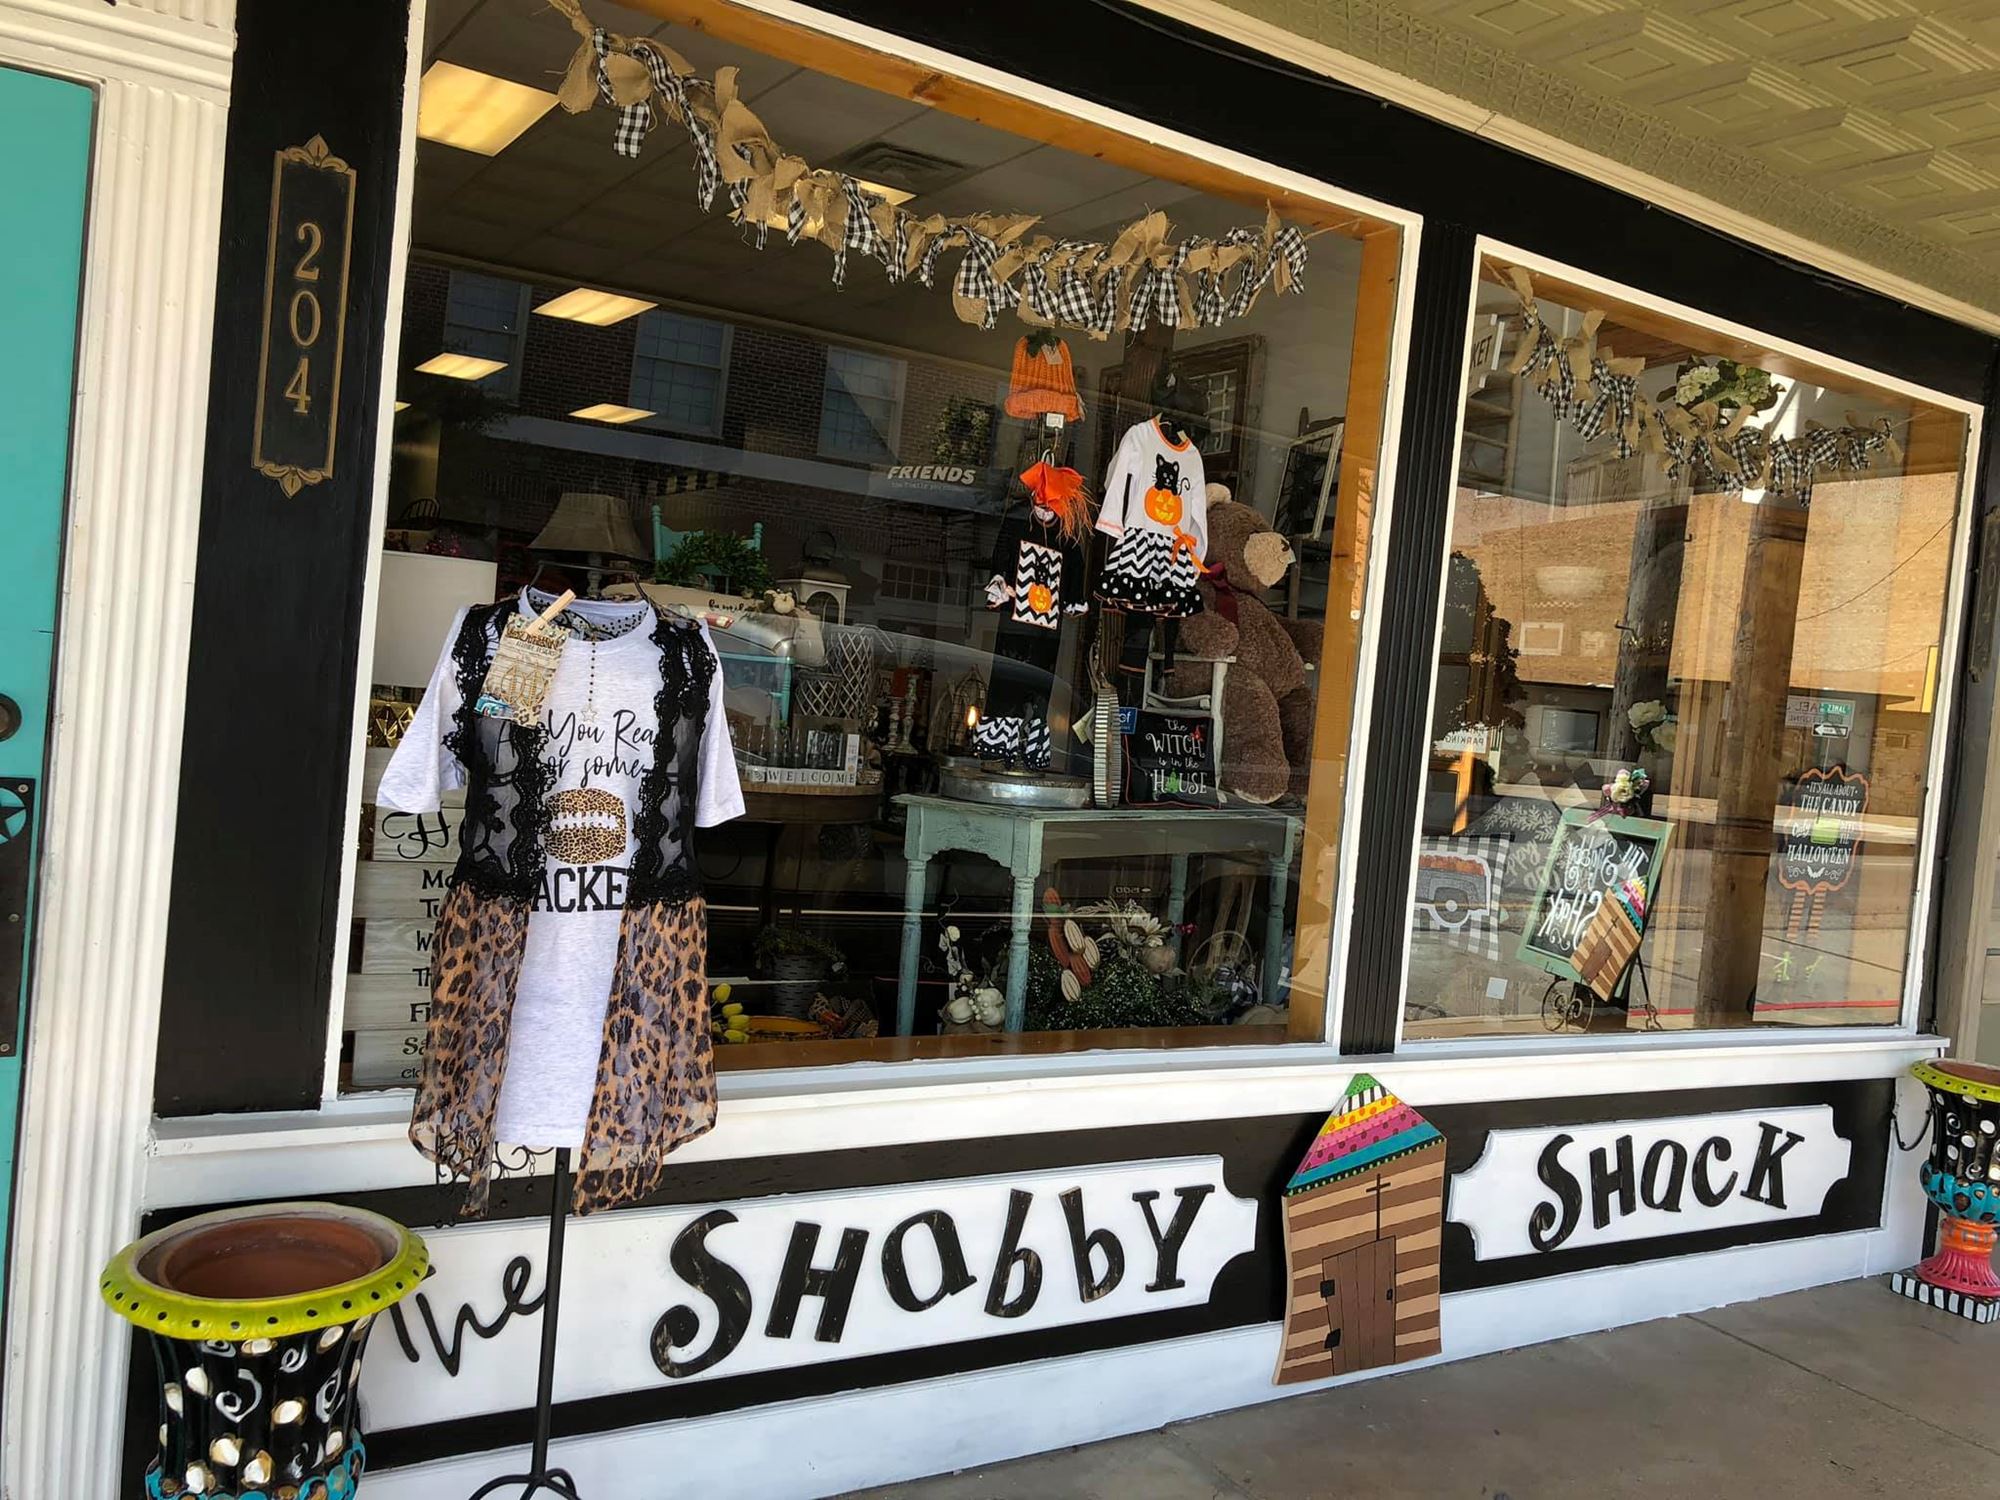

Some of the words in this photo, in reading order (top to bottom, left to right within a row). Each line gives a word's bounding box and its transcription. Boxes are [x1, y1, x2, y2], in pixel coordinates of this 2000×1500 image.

[285, 222, 322, 416] 204
[887, 465, 976, 485] FRIENDS
[548, 709, 604, 757] You
[613, 709, 655, 754] Rea
[1145, 732, 1206, 758] WITCH
[580, 752, 645, 788] some
[768, 769, 855, 784] WELCOME
[1800, 794, 1819, 813] THE
[1821, 797, 1860, 816] CANDY
[1786, 844, 1852, 865] HALLOWEEN
[530, 865, 630, 913] ACKE
